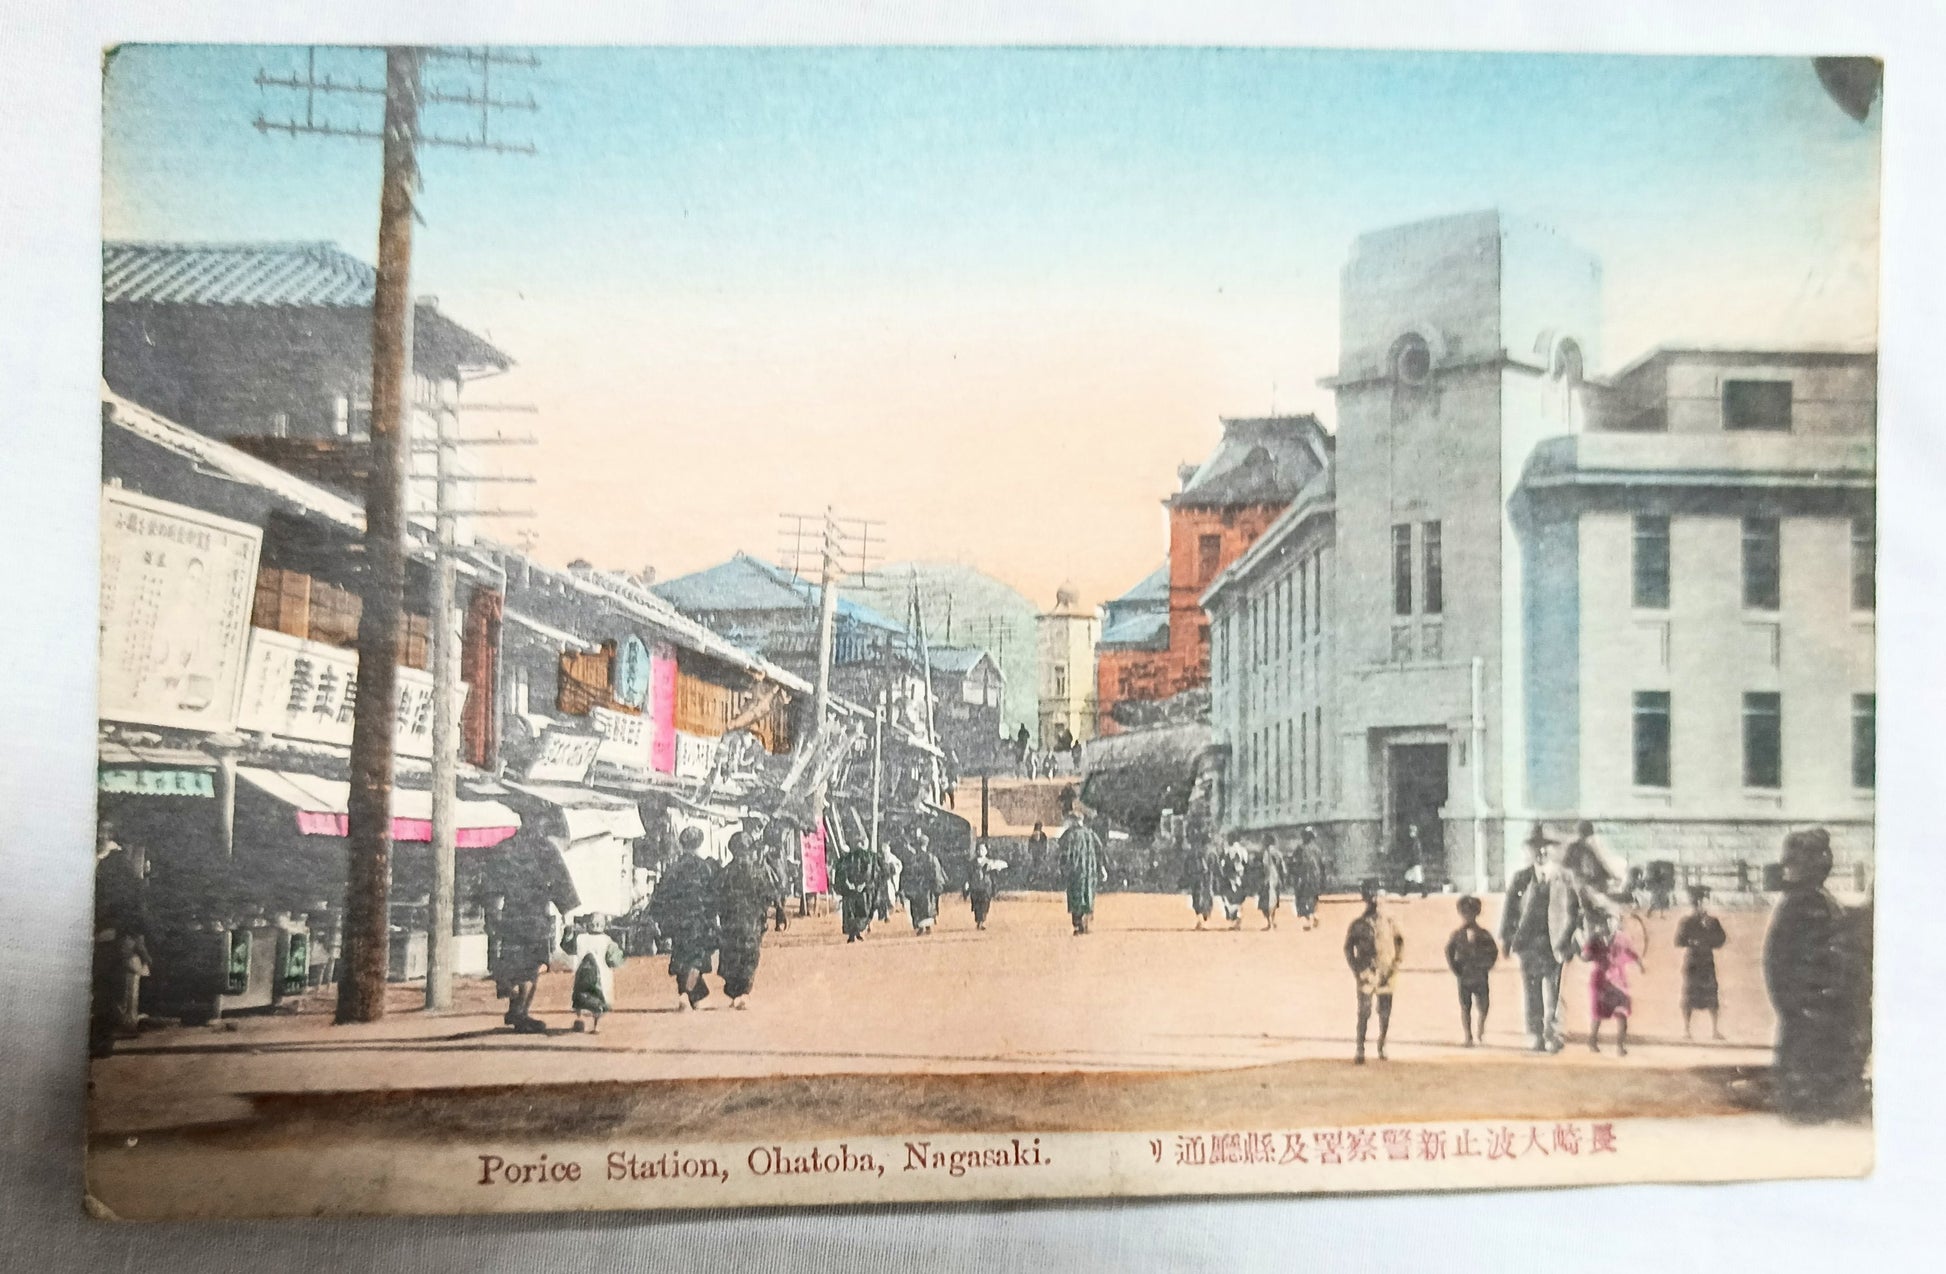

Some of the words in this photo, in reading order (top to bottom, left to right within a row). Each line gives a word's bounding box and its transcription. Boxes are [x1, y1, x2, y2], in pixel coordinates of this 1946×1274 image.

[478, 1153, 581, 1185] Porice
[607, 1150, 729, 1183] Station,
[748, 1144, 885, 1177] Ohatoba,
[904, 1138, 1051, 1177] Nagasaki.
